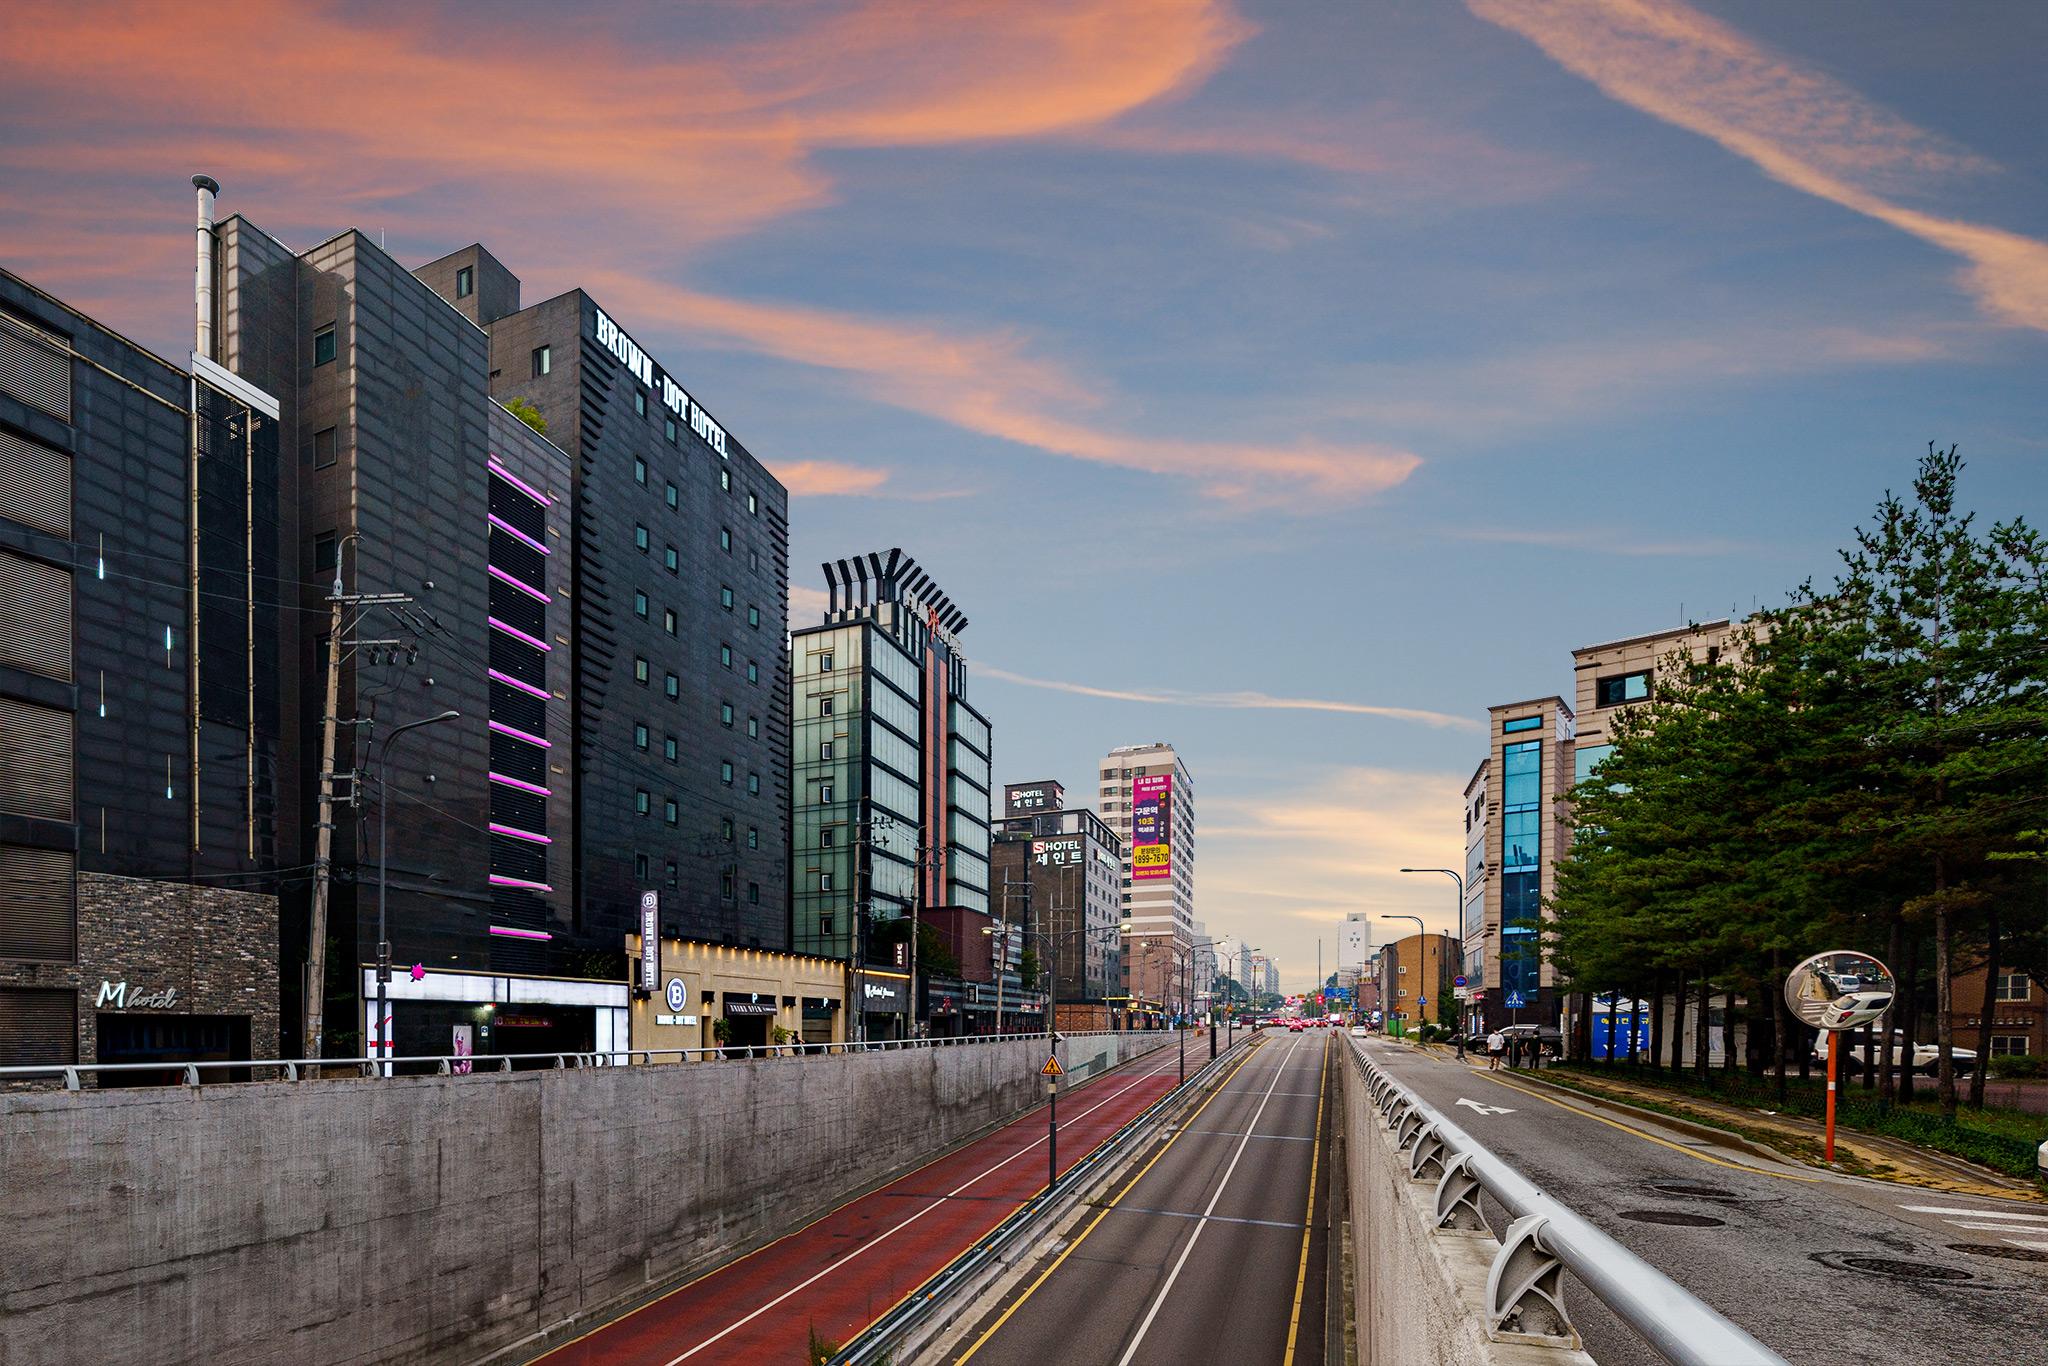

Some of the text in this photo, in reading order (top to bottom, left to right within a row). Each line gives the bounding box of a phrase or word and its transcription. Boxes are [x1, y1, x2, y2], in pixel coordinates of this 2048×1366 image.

[690, 401, 729, 460] HOTEL
[1045, 840, 1081, 852] HOTEL
[1036, 851, 1083, 866] 세인트
[1134, 853, 1168, 864] 1899-7670
[95, 981, 177, 1009] M hotel
[671, 985, 683, 1004] B
[752, 992, 758, 1004] P
[823, 997, 829, 1007] P
